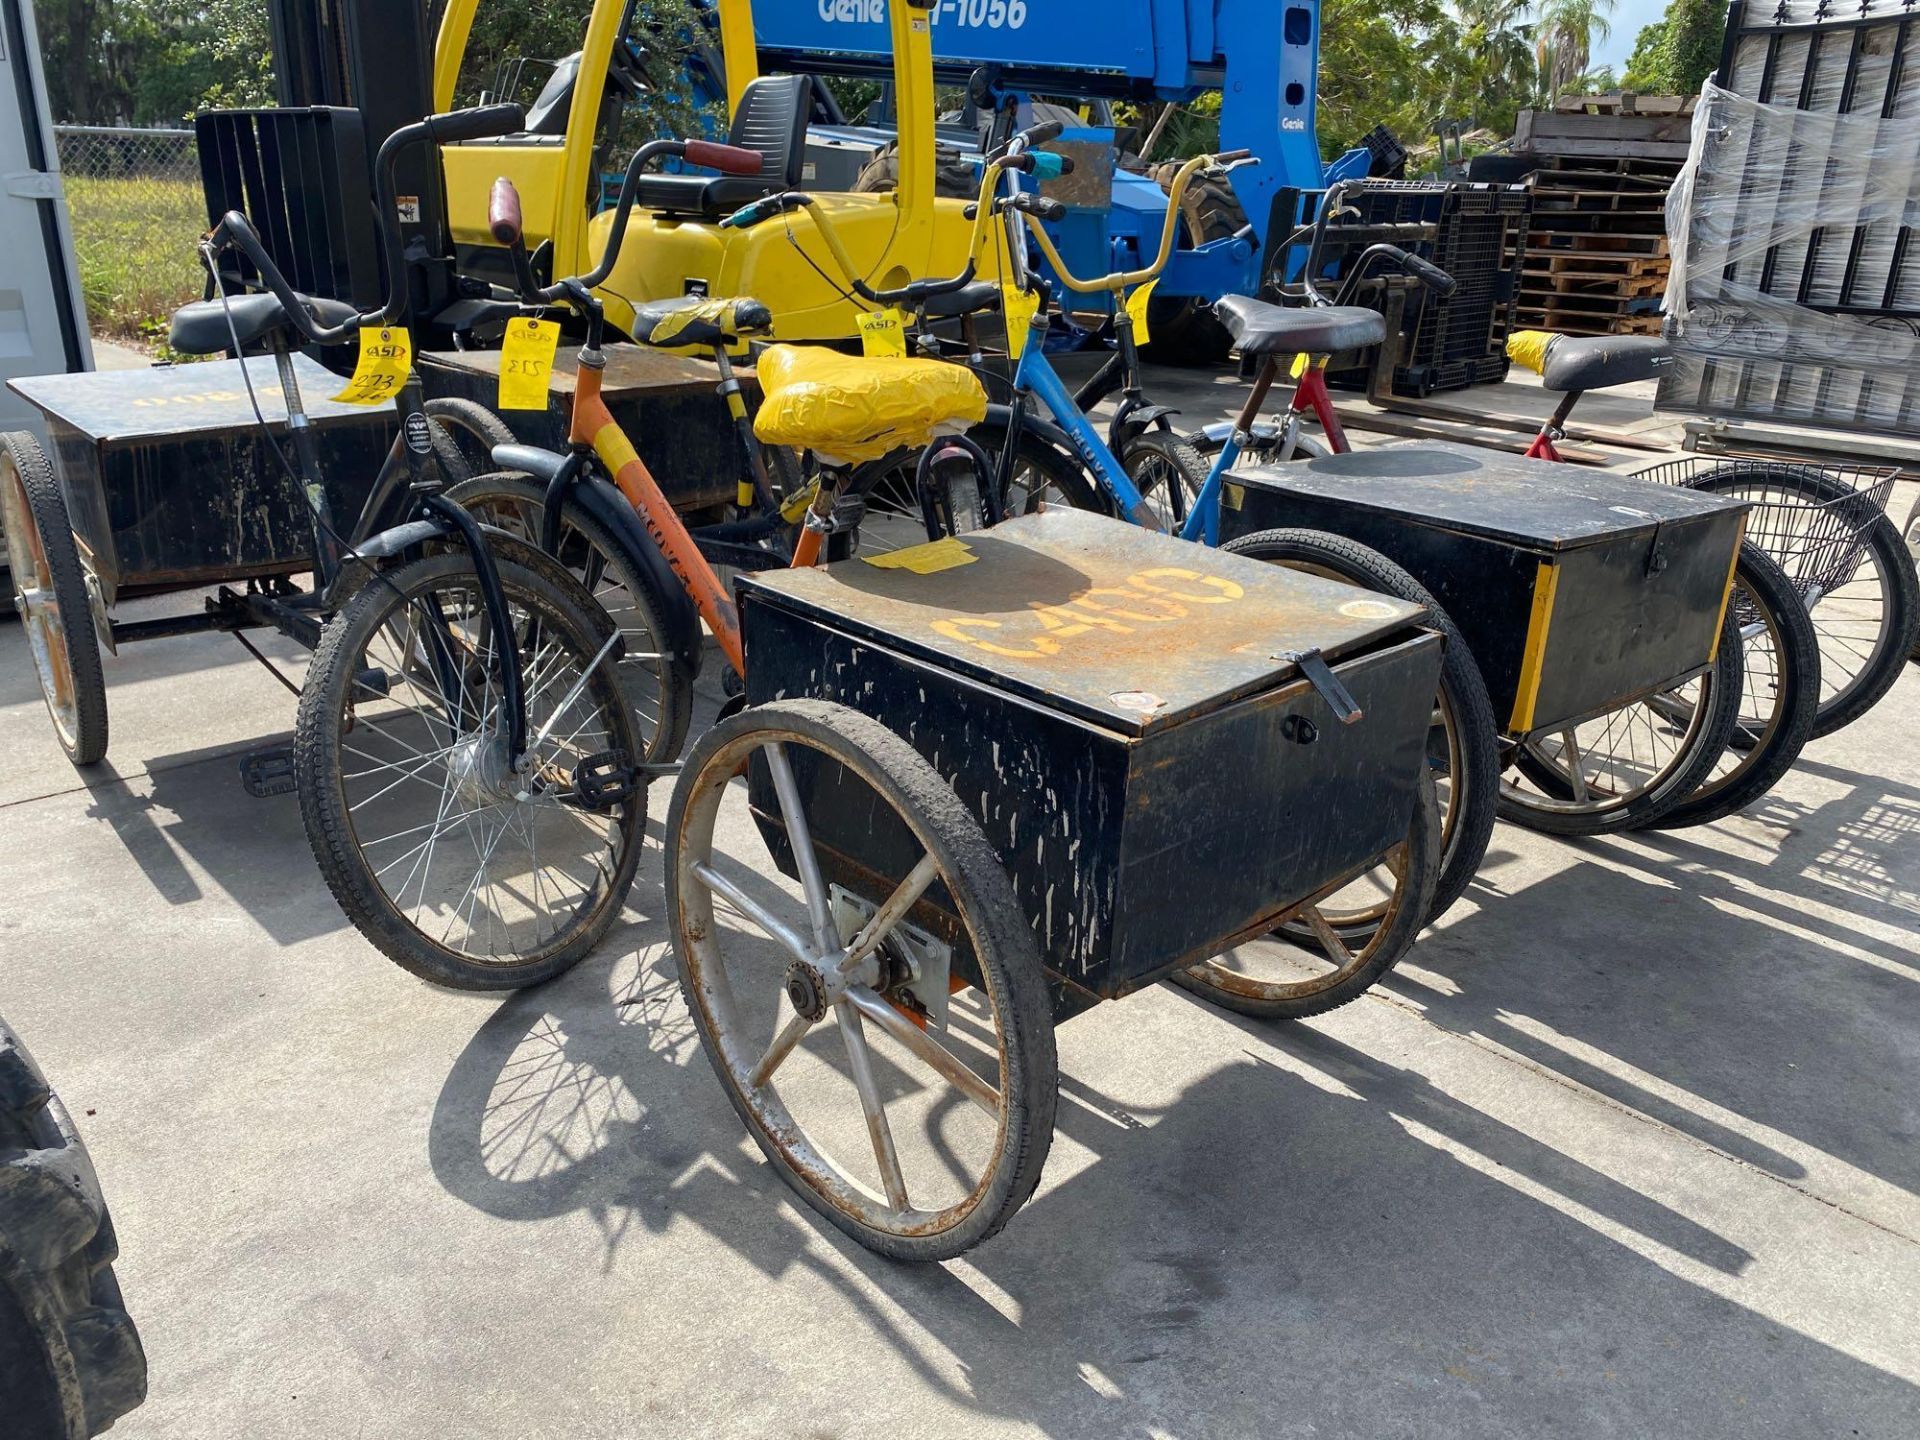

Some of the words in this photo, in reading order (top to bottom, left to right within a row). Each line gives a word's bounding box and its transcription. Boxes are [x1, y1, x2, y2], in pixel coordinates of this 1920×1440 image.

[818, 0, 884, 23] Genie
[1282, 117, 1304, 130] Genie
[353, 374, 396, 391] 273
